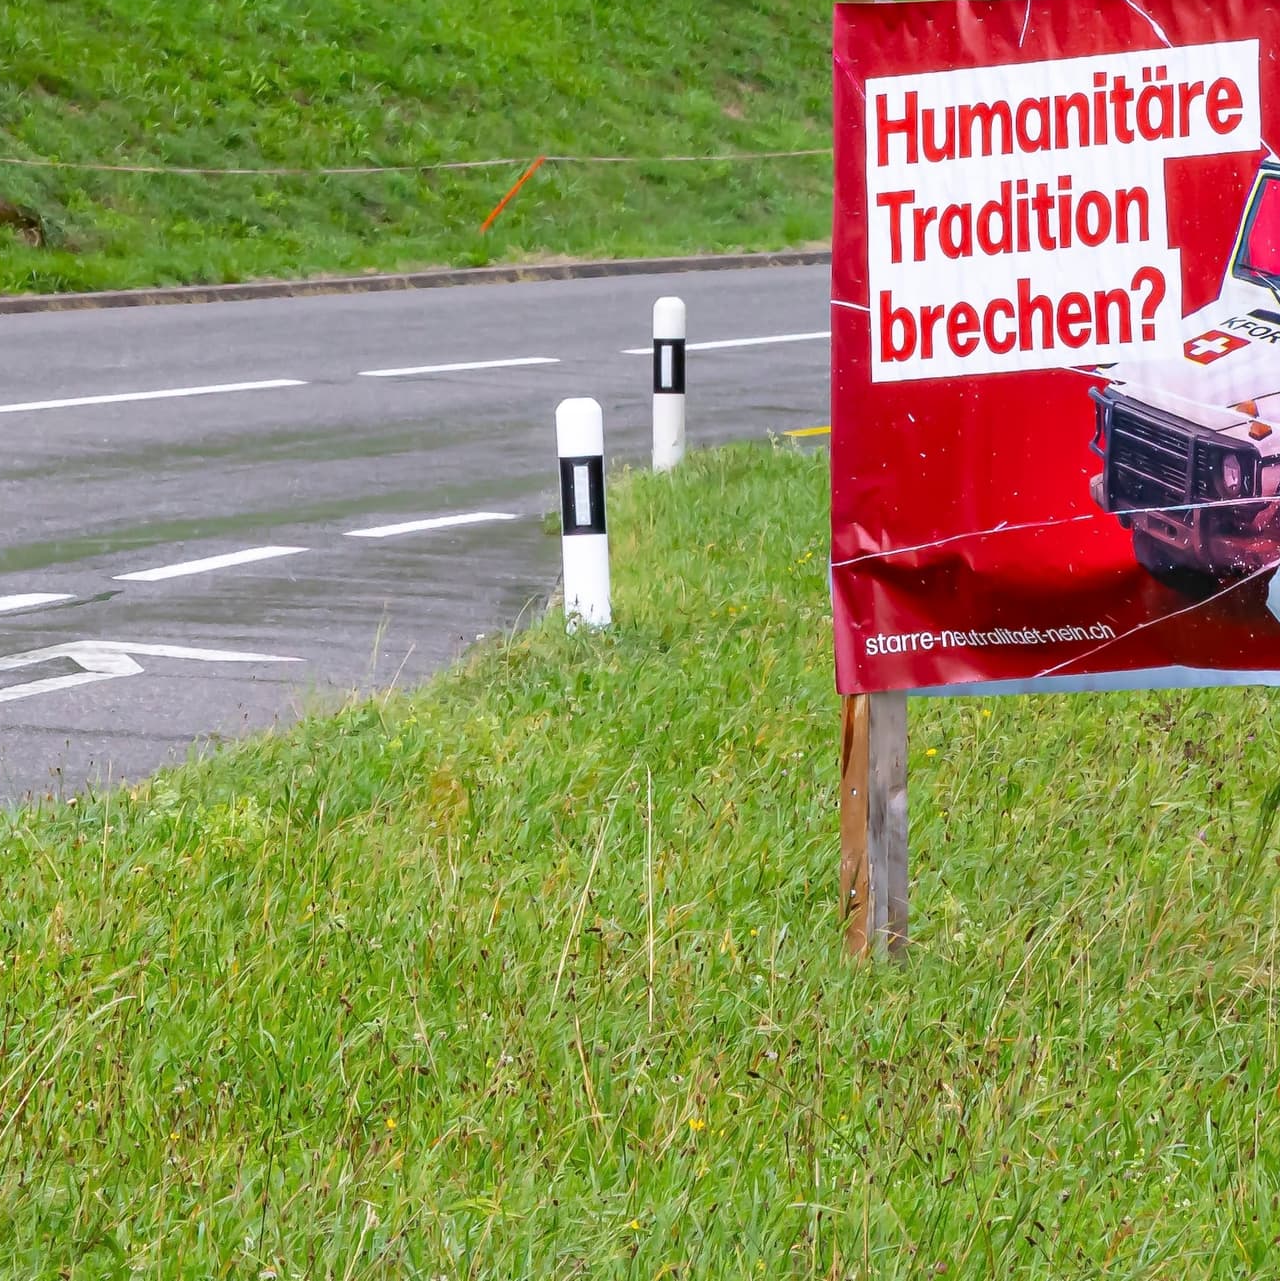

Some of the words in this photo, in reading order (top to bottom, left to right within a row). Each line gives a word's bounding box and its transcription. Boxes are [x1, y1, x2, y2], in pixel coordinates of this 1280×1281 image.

[876, 65, 1244, 167] Humanitäre
[876, 174, 1150, 263] Tradition
[879, 266, 1167, 362] brechen?
